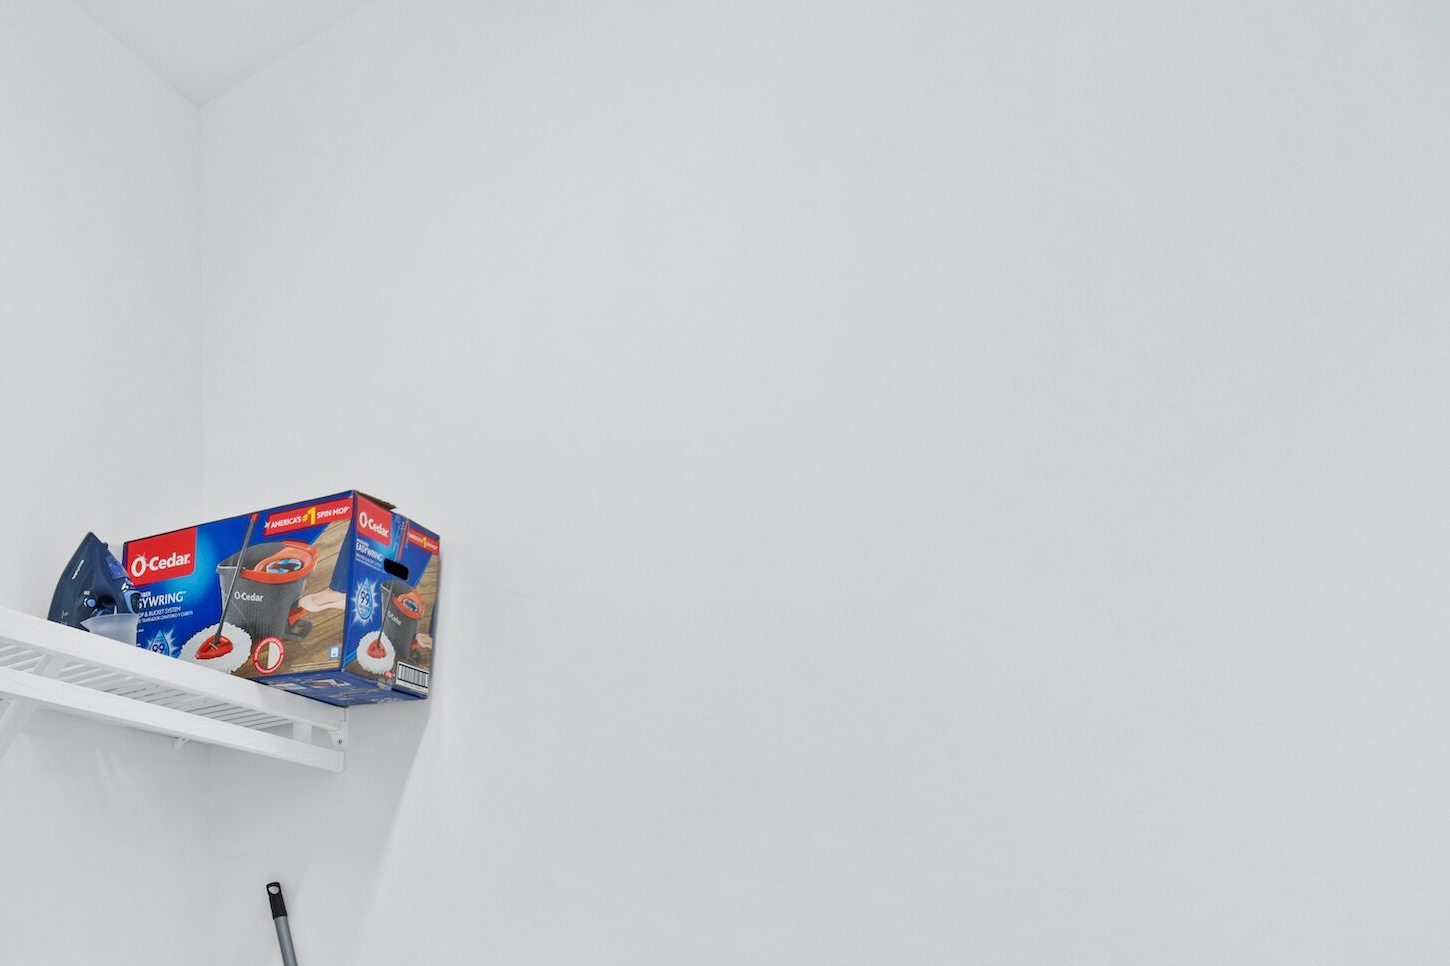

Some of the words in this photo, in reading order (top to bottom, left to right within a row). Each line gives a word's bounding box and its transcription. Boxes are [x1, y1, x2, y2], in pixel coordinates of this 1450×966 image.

[271, 516, 302, 529] AMERICA'S
[302, 507, 316, 525] #1
[316, 510, 332, 519] SPIN
[332, 506, 348, 515] MOP
[131, 552, 191, 577] O-Cedar
[234, 591, 264, 602] O-Cedar
